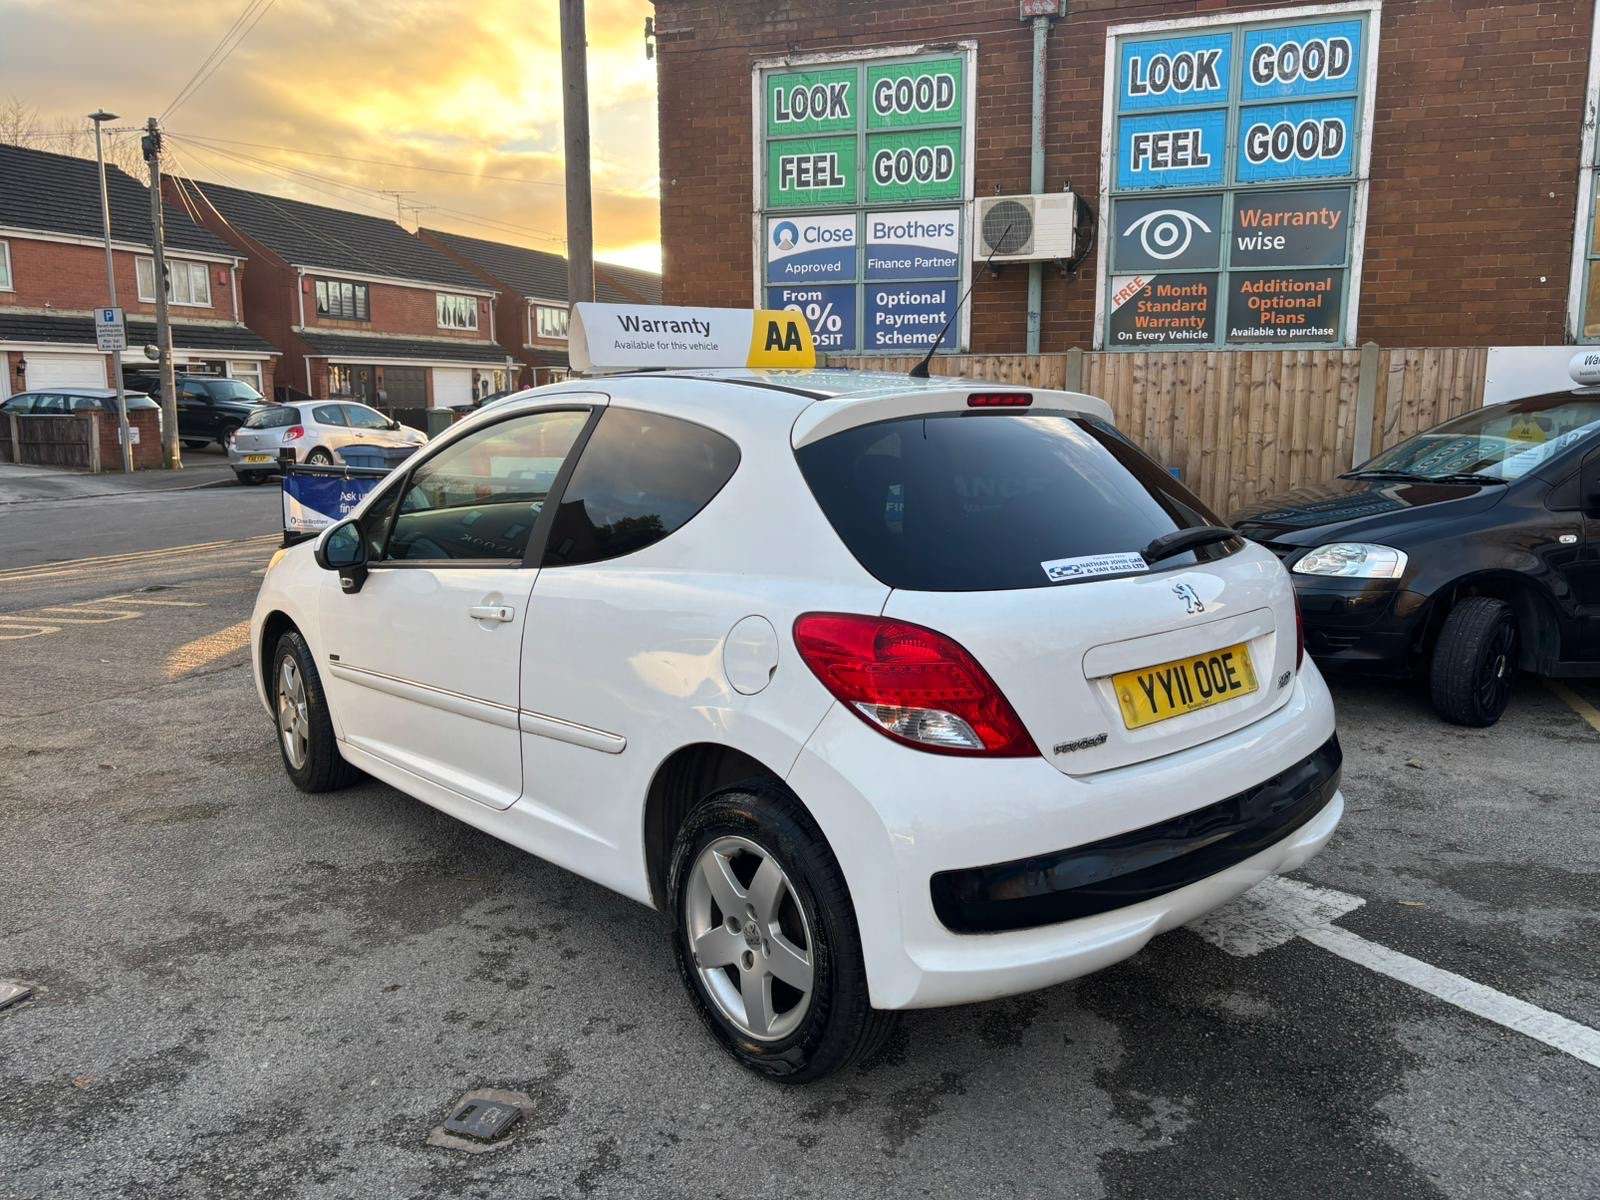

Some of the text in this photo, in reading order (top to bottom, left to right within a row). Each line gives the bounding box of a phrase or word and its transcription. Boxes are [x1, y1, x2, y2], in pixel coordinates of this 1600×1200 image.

[1129, 37, 1352, 96] LOOK GOOD
[774, 73, 955, 123] LOOK GOOD
[1131, 118, 1346, 171] FEEL GOOD
[780, 145, 954, 190] FEEL GOOD
[1239, 208, 1342, 229] Warranty
[803, 221, 955, 243] Close Brothers
[1237, 232, 1286, 250] wise
[785, 257, 957, 275] Approved Finance Partner
[1113, 275, 1145, 306] FREE
[1143, 283, 1207, 297] 3 Month
[1240, 278, 1332, 293] Additional
[783, 291, 822, 301] From
[876, 290, 946, 308] Optional
[1248, 295, 1322, 311] Optional
[1137, 299, 1207, 312] Standard
[617, 315, 710, 337] Warranty
[876, 311, 947, 327] Payment
[1135, 316, 1205, 329] Warranty
[1260, 312, 1305, 324] Plans
[764, 321, 803, 351] AA
[811, 334, 843, 345] OSIT
[876, 331, 945, 344] Schemes
[1118, 330, 1208, 340] On Every Vehicle
[1231, 326, 1334, 337] Available to purchase
[615, 340, 719, 350] Available for this vehicle
[340, 491, 356, 501] Ask
[1137, 665, 1194, 714] YY11
